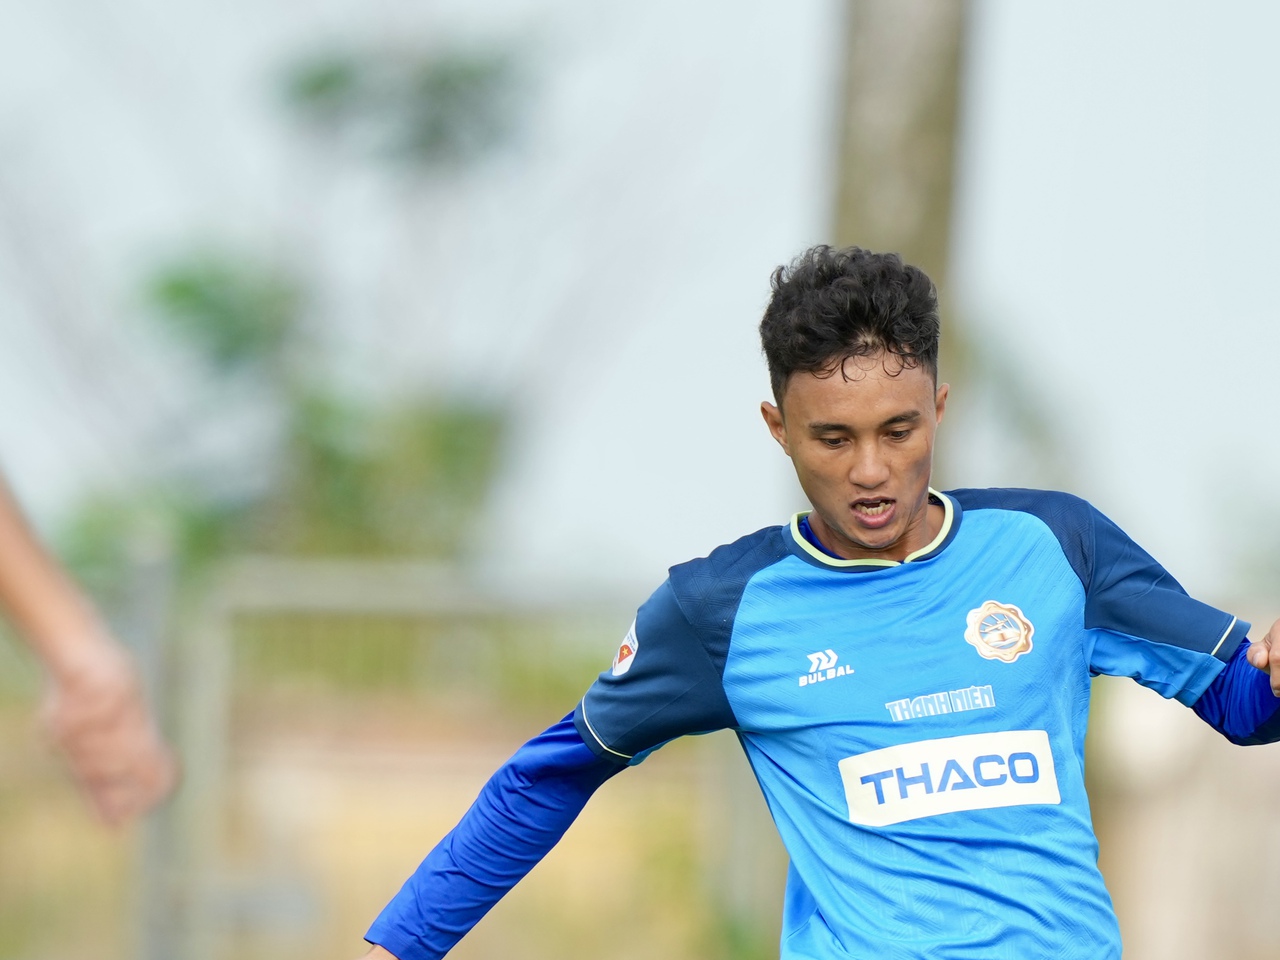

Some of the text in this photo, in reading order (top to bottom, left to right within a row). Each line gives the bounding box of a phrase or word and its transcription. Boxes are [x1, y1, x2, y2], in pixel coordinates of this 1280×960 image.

[798, 664, 855, 687] BULBAL
[885, 685, 996, 722] THANH NIÊN
[860, 752, 1040, 805] THACO
